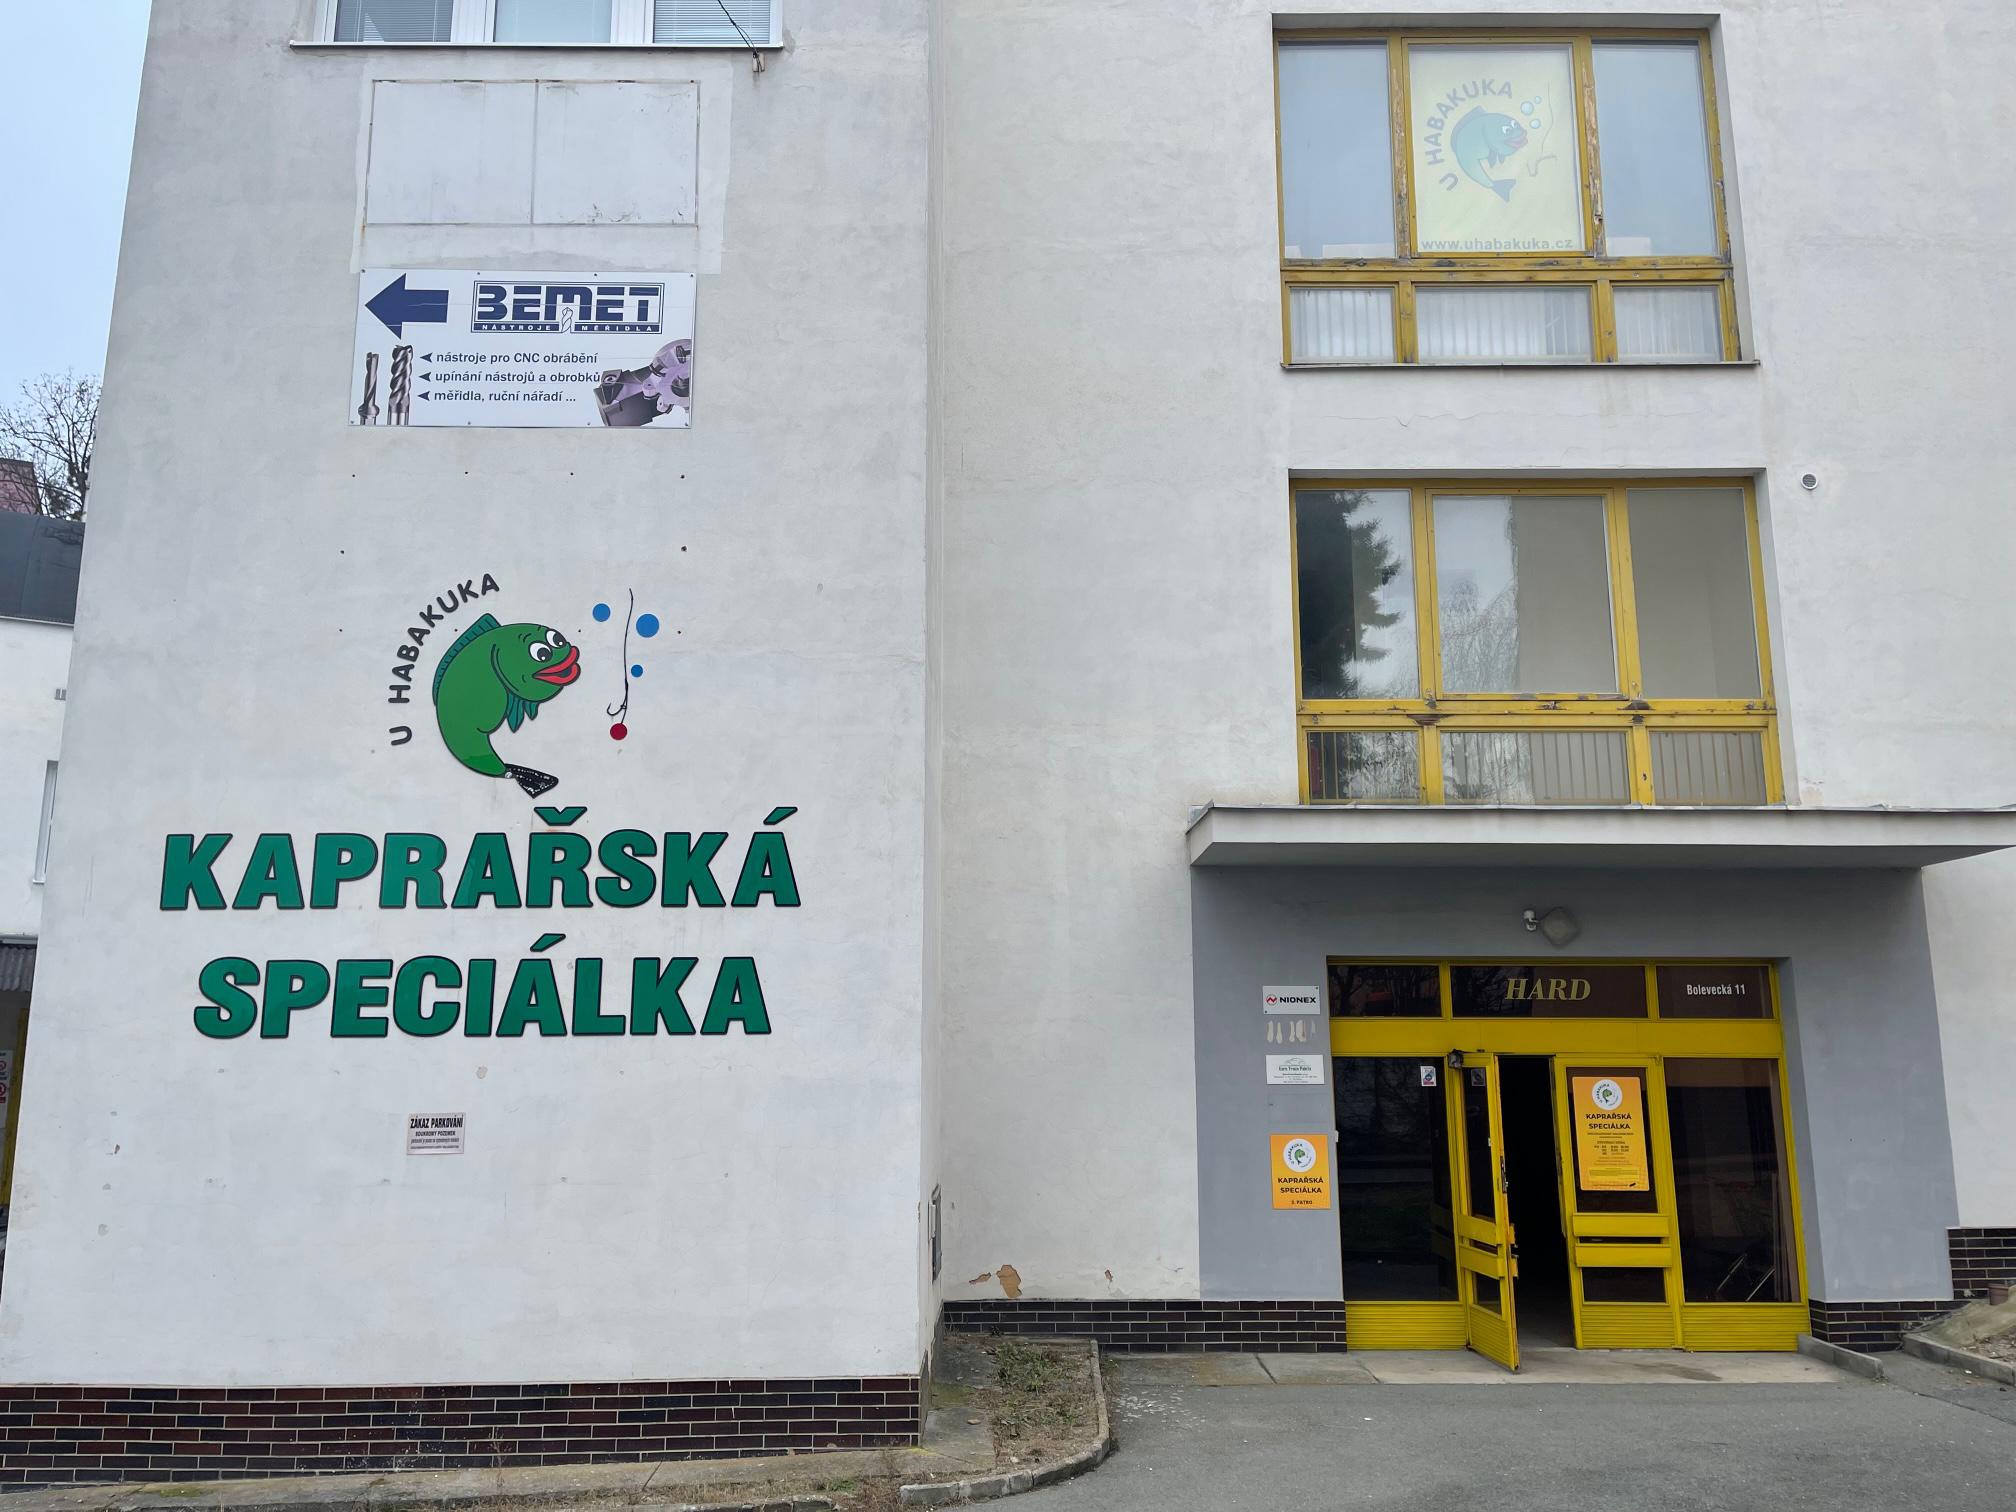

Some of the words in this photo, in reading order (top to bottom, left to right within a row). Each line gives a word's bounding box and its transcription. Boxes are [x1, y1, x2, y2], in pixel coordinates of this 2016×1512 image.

[1424, 79, 1513, 166] HABAKUKA
[1439, 173, 1459, 191] U
[1422, 237, 1574, 251] www.uhabakuka.cz
[477, 285, 659, 321] BEMET
[581, 324, 653, 332] MĚŘIDLA
[436, 353, 487, 364] nástroje
[490, 355, 510, 364] pro
[513, 353, 540, 363] CNC
[543, 352, 598, 364] obrábění
[435, 371, 482, 383] upínání
[485, 371, 535, 384] nástrojů
[550, 371, 600, 383] obrobků
[434, 389, 485, 402] měřidla,
[489, 390, 519, 401] ruční
[523, 391, 563, 402] nářadí
[387, 573, 500, 704] HABAKUKA
[388, 725, 412, 746] U
[159, 806, 802, 911] KAPRAŘSKÁ
[193, 932, 773, 1039] SPECIÁLKA
[1505, 978, 1592, 1001] HARD
[1687, 984, 1732, 995] Bolevecká
[1735, 984, 1745, 995] 11
[410, 1115, 430, 1129] ZÁKAZ
[431, 1114, 463, 1128] PARKOVÁNÍ
[1586, 1112, 1632, 1120] KAPRAŘSKÁ
[1589, 1122, 1631, 1130] SPECIÁLKA
[1278, 1176, 1324, 1184] KAPRAŘSKÁ
